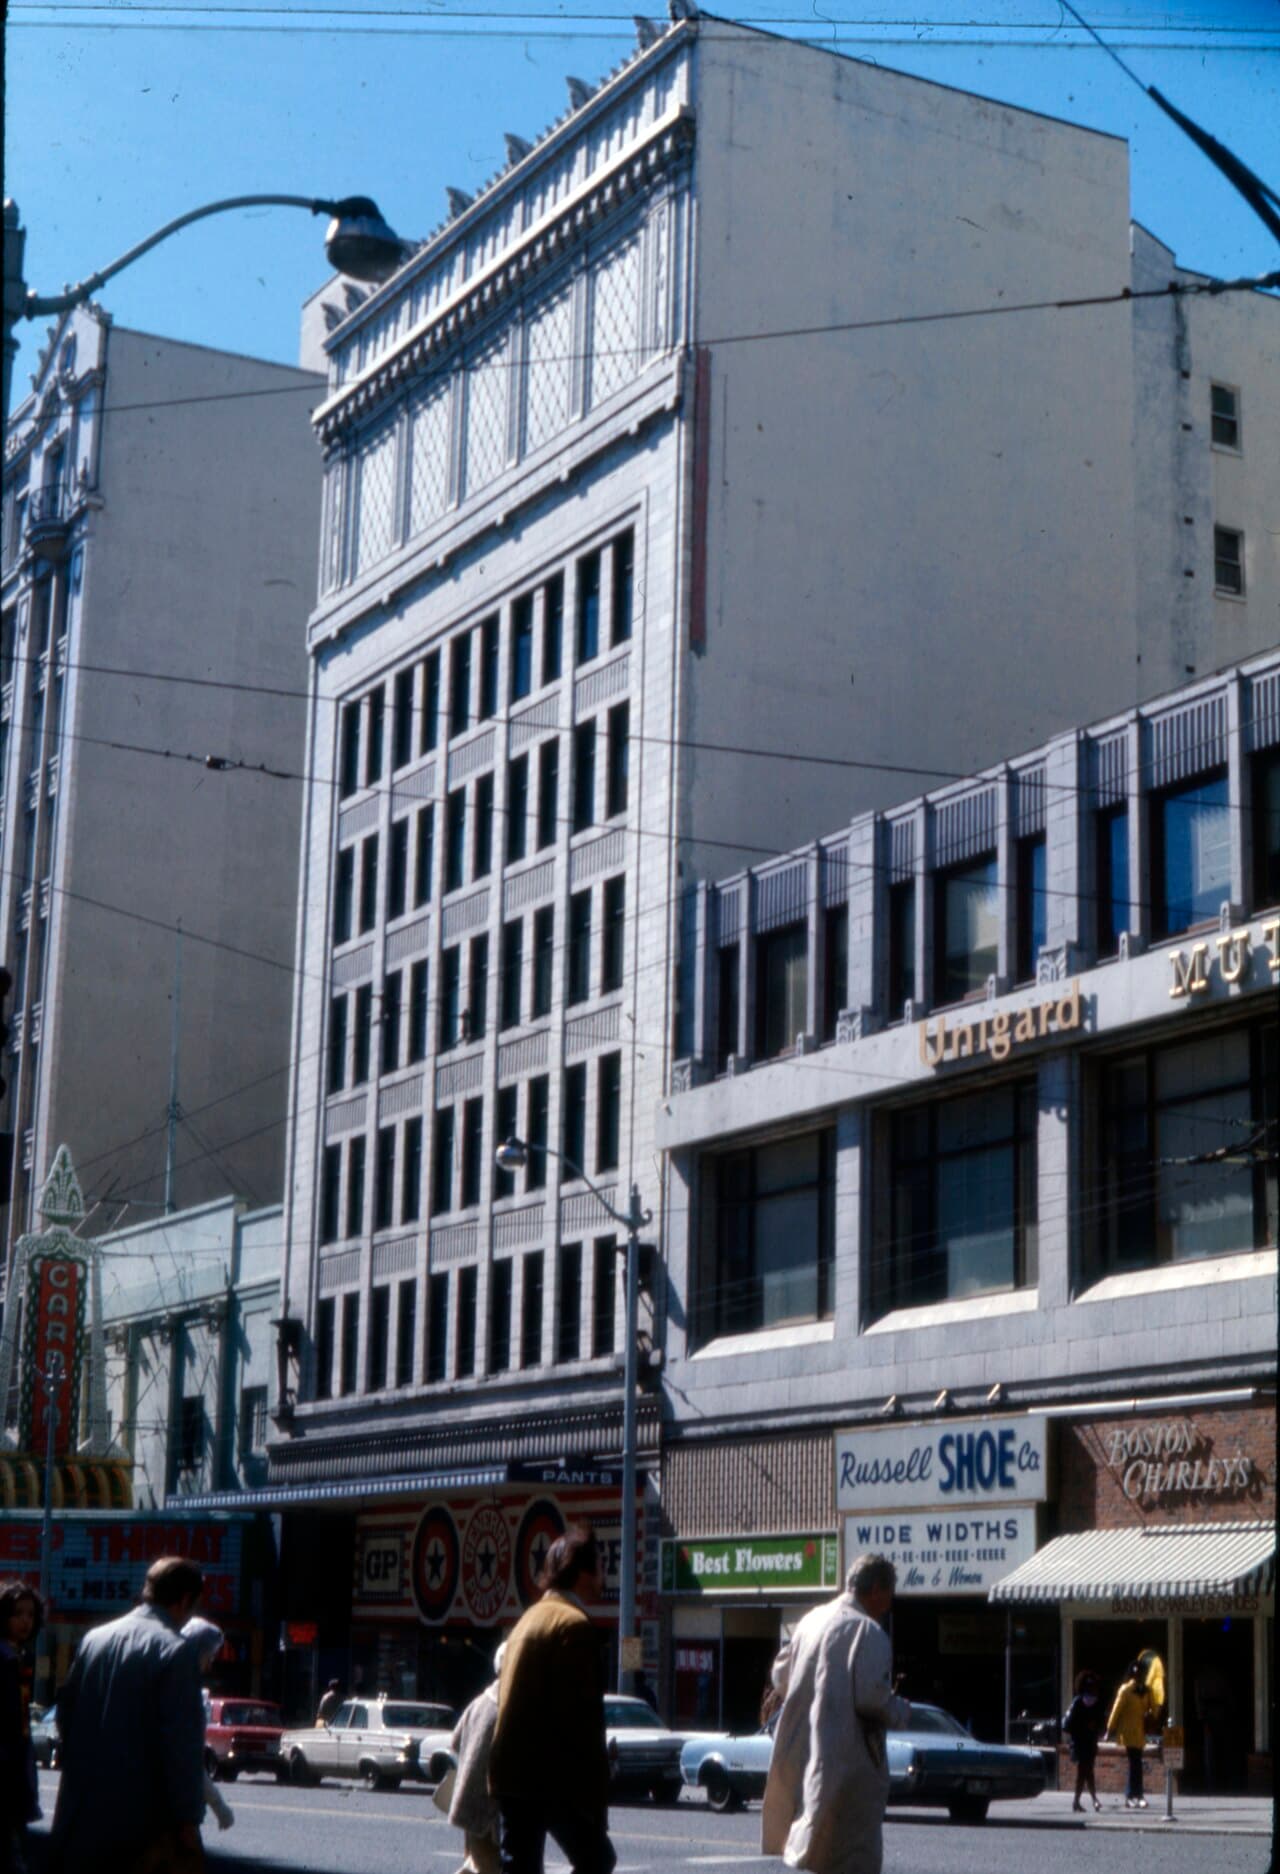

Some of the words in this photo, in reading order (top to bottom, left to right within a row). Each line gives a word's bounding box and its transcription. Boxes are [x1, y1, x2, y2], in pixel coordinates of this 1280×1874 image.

[918, 979, 1081, 1067] Unigard
[839, 1446, 934, 1489] Russell
[938, 1428, 1016, 1493] SHOE
[1108, 1423, 1198, 1467] BOSTON
[542, 1470, 613, 1485] PANTS
[1123, 1450, 1250, 1500] CHARLEY'S
[86, 1524, 227, 1564] THROAT
[856, 1525, 912, 1544] WIDE
[926, 1519, 1018, 1542] WIDTHS
[366, 1550, 398, 1580] GP
[692, 1552, 730, 1576] Best
[734, 1546, 803, 1573] Flowers
